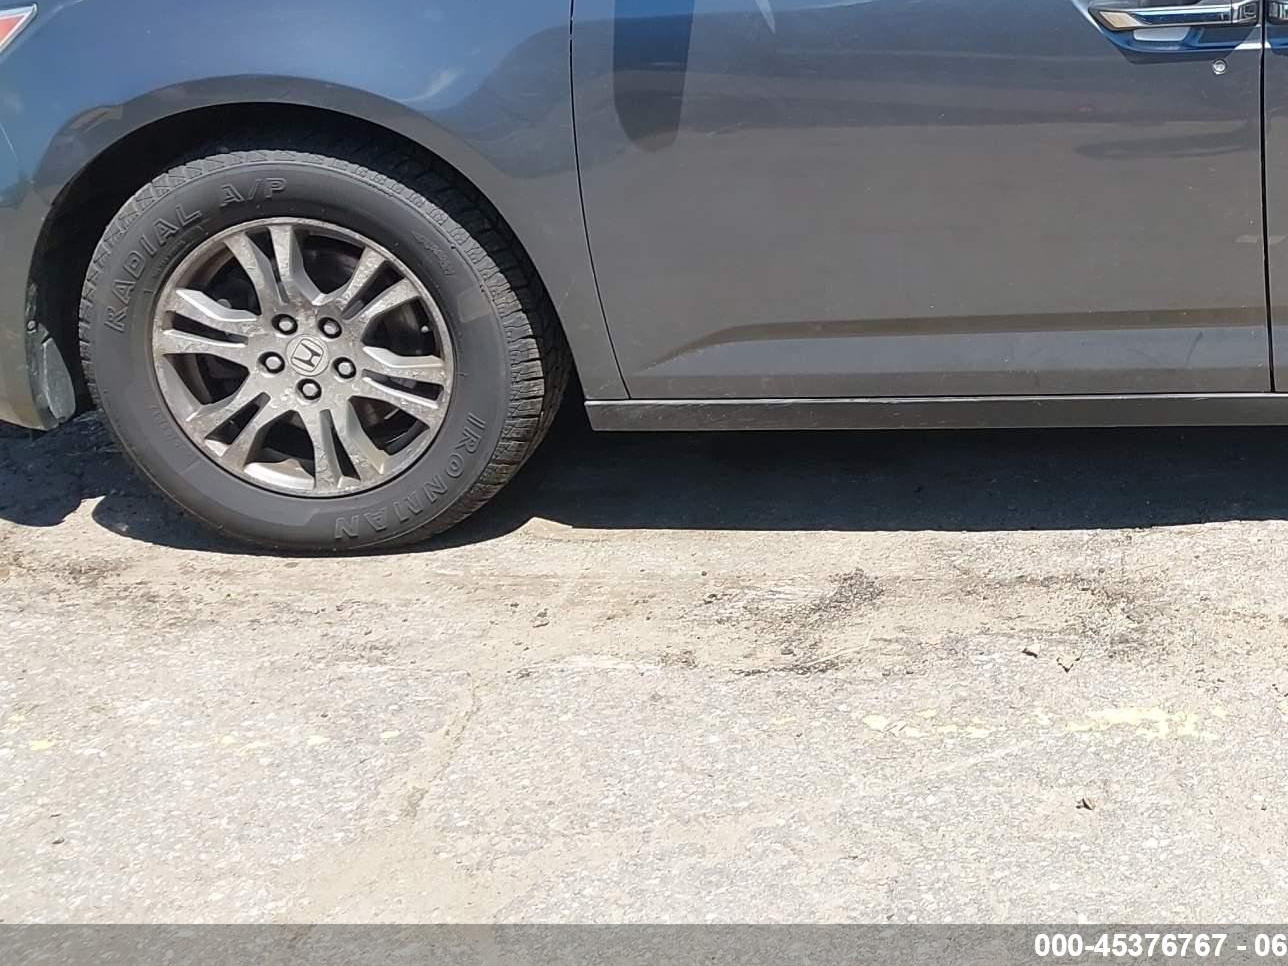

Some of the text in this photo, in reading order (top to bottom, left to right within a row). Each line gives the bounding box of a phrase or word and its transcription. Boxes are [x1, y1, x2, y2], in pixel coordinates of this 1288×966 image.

[104, 207, 202, 332] RADIAL
[220, 177, 287, 206] A/P
[334, 413, 487, 541] IRONMAN
